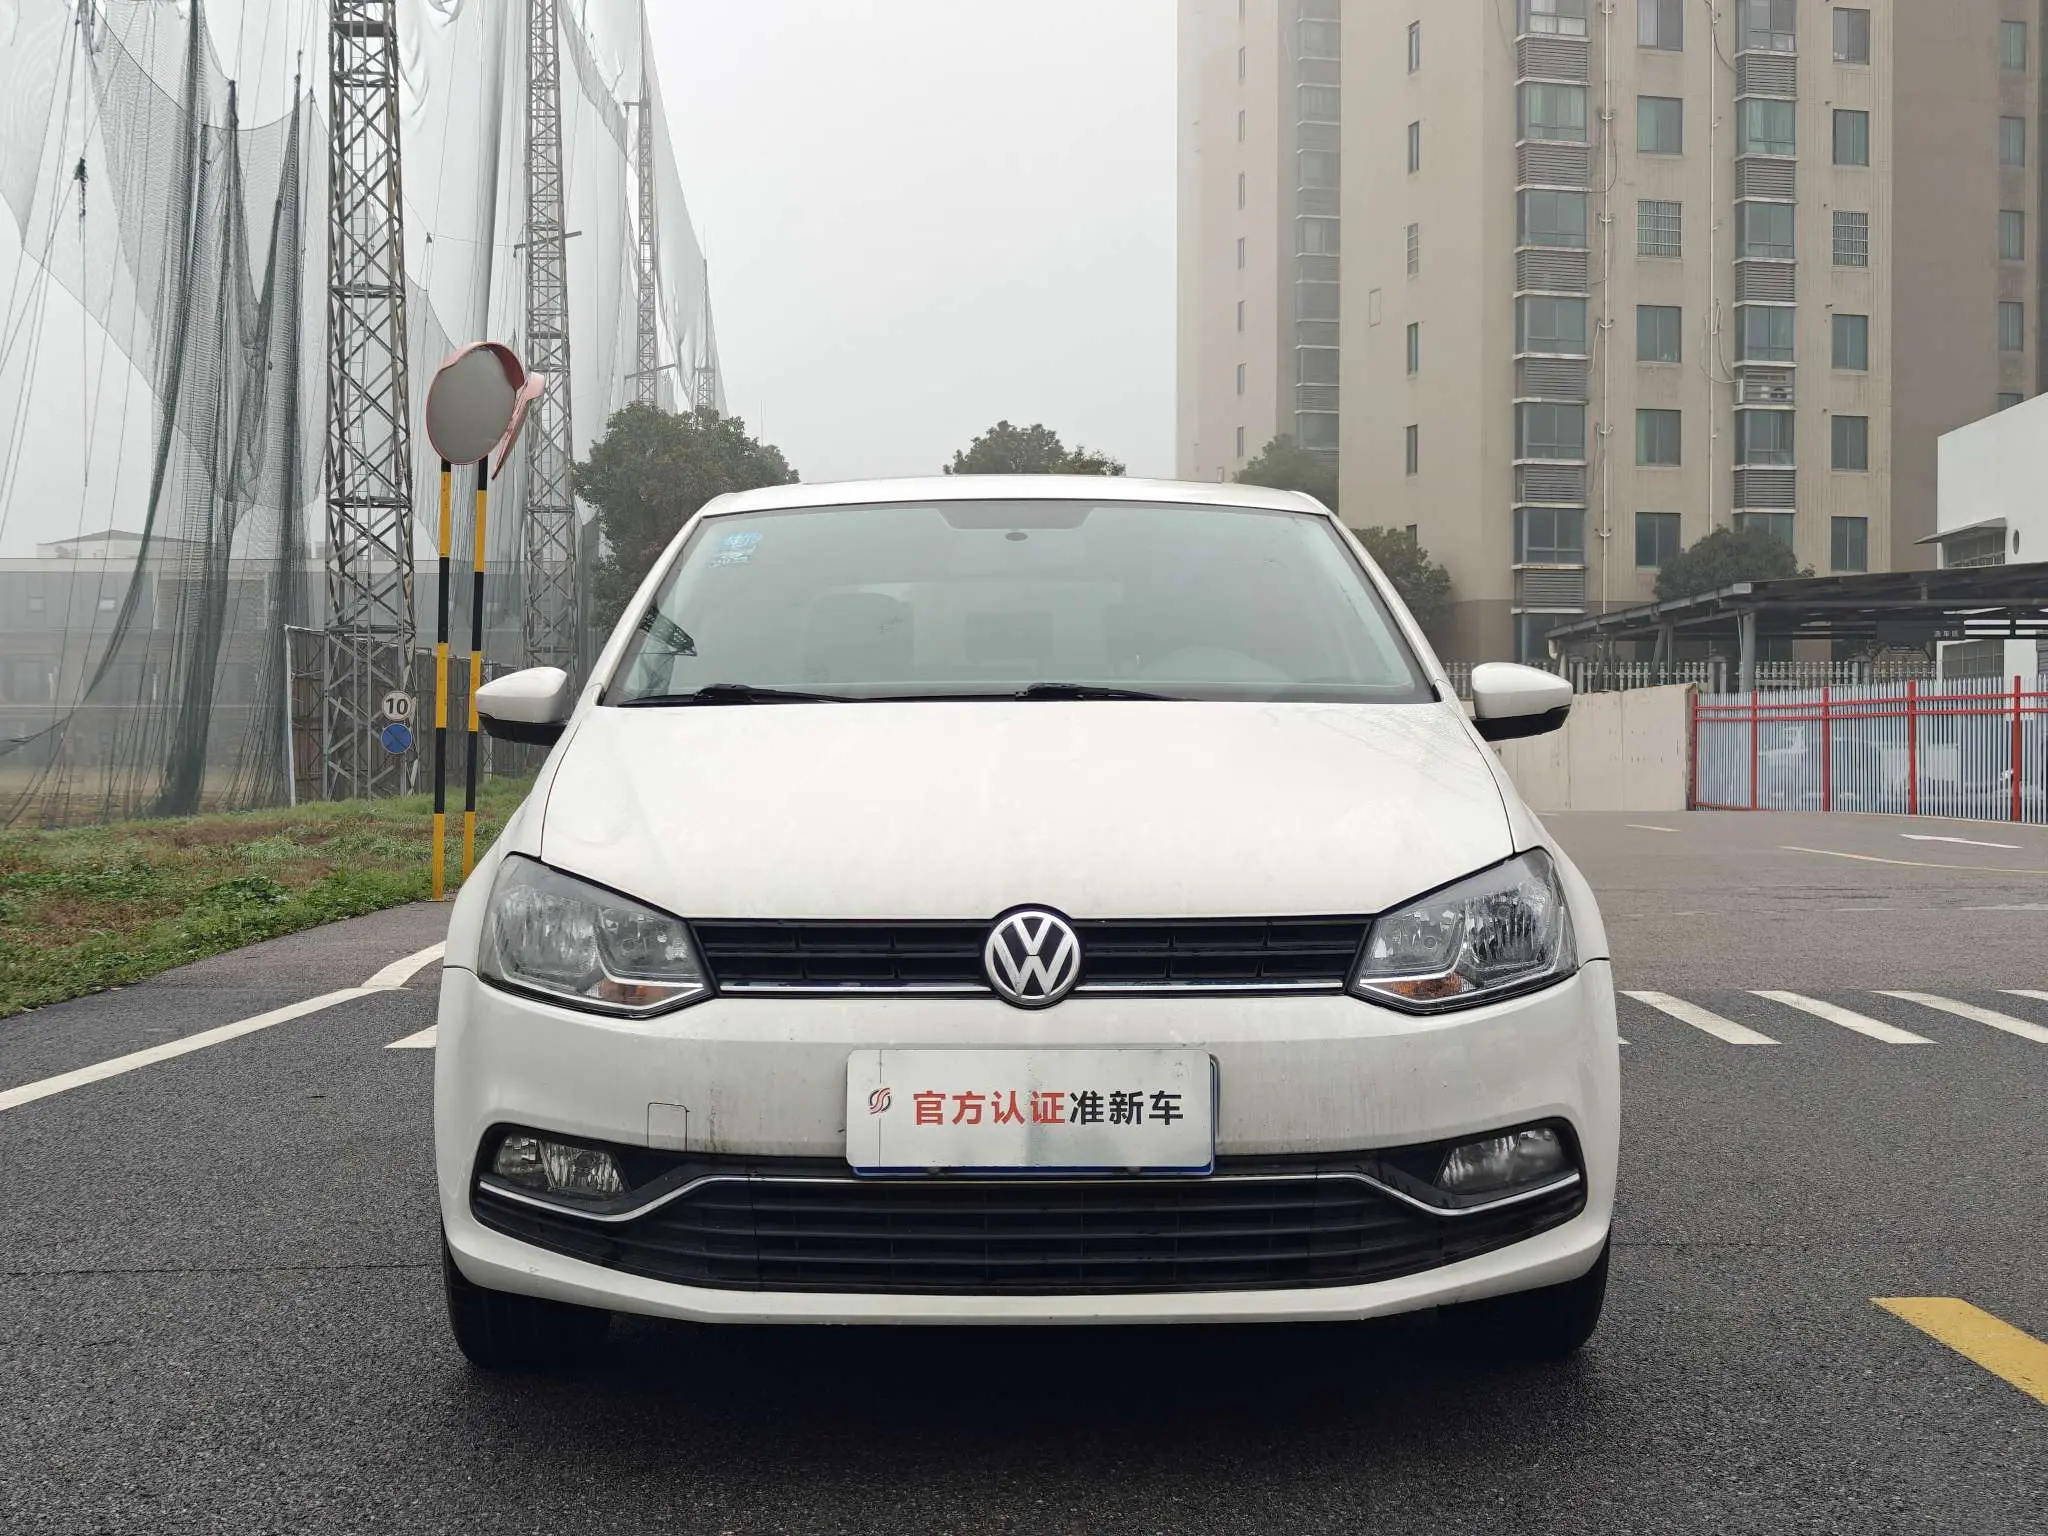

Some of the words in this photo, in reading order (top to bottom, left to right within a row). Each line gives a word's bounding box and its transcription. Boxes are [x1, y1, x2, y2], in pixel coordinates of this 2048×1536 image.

[386, 698, 408, 714] 10
[913, 1090, 1184, 1125] 官方认证准新车
